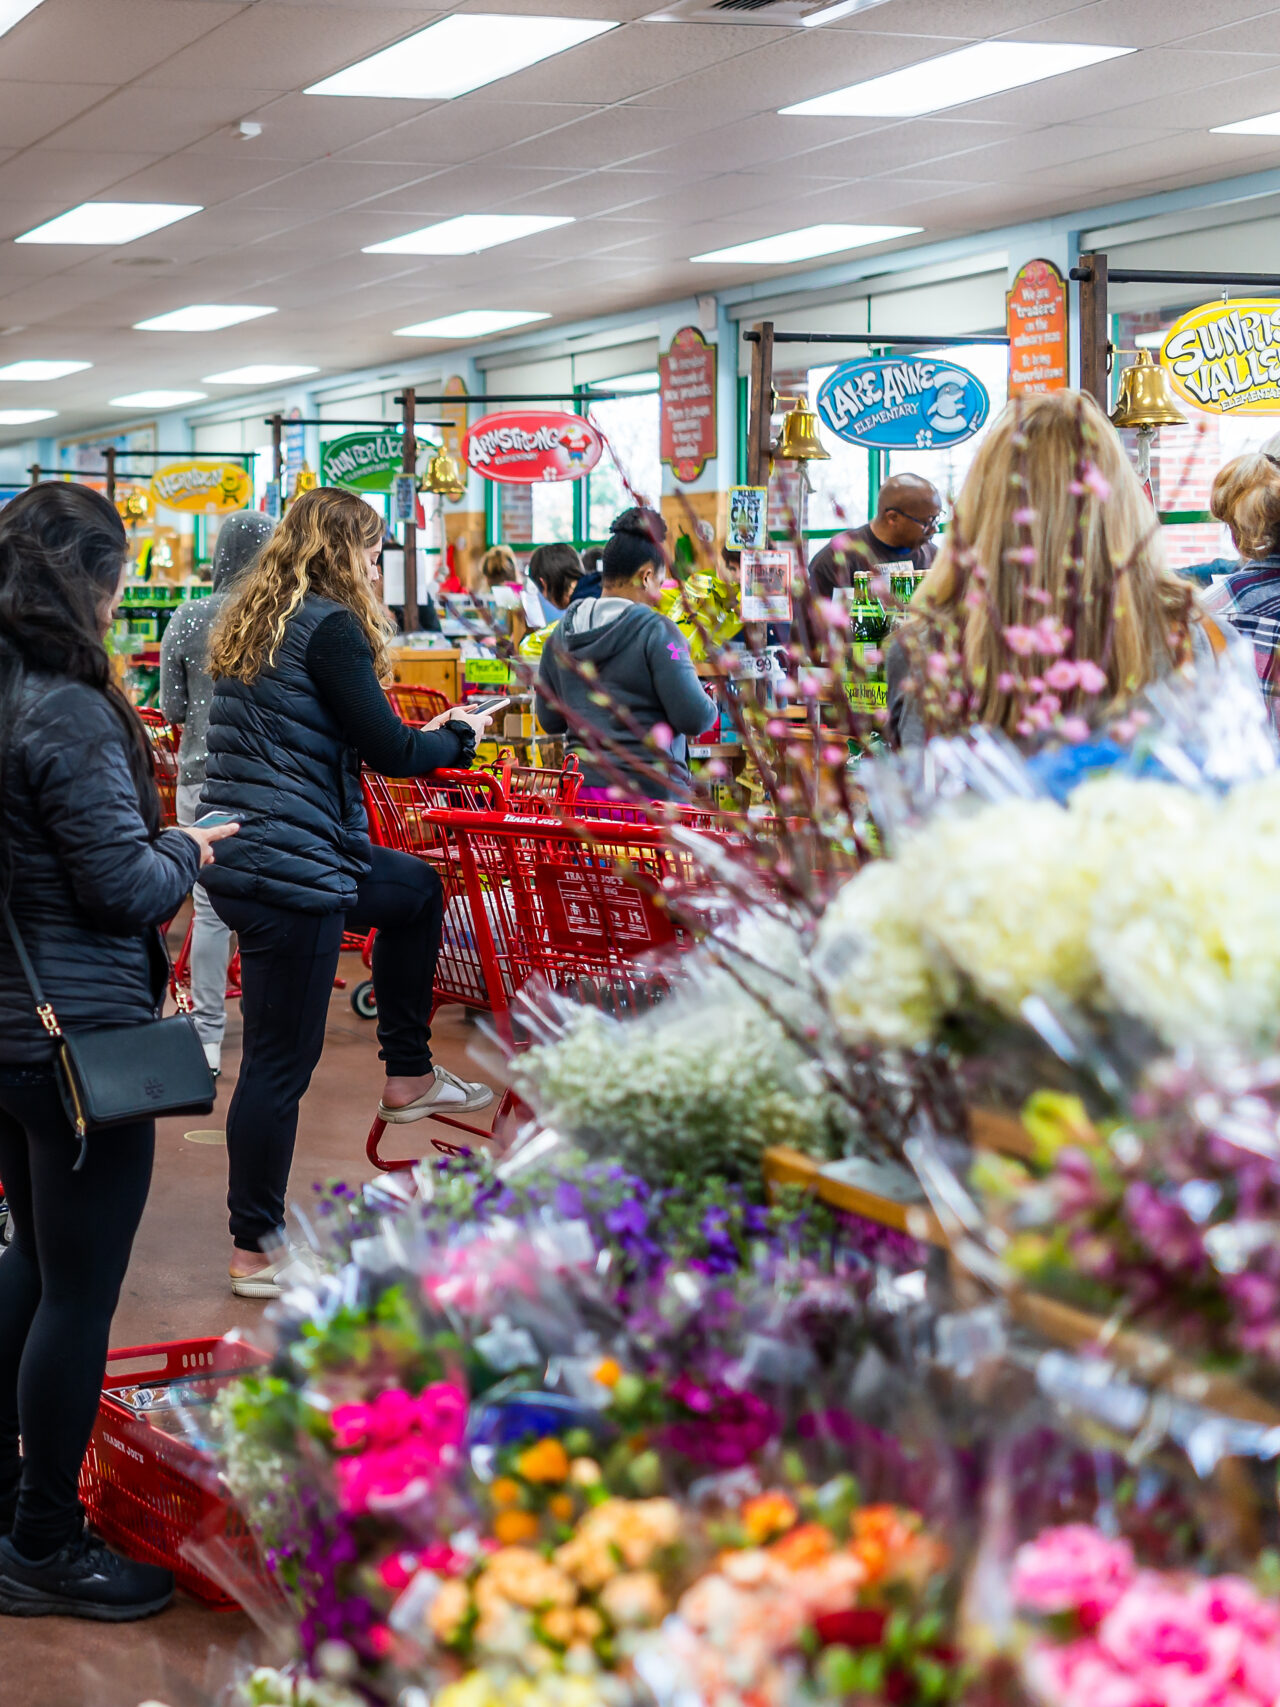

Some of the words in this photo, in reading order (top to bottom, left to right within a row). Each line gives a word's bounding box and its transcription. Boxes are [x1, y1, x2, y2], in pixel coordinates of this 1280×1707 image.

[1165, 307, 1280, 377] SUNRIS
[1184, 348, 1280, 404] VALLE
[820, 370, 883, 432] LAKE
[881, 361, 936, 409] ANNE
[1220, 387, 1280, 412] ELEMENTA
[853, 401, 920, 435] ELEMENTARY
[468, 425, 560, 467] ARMSTRONG
[503, 814, 538, 824] TRADER
[564, 871, 598, 883] TRAER
